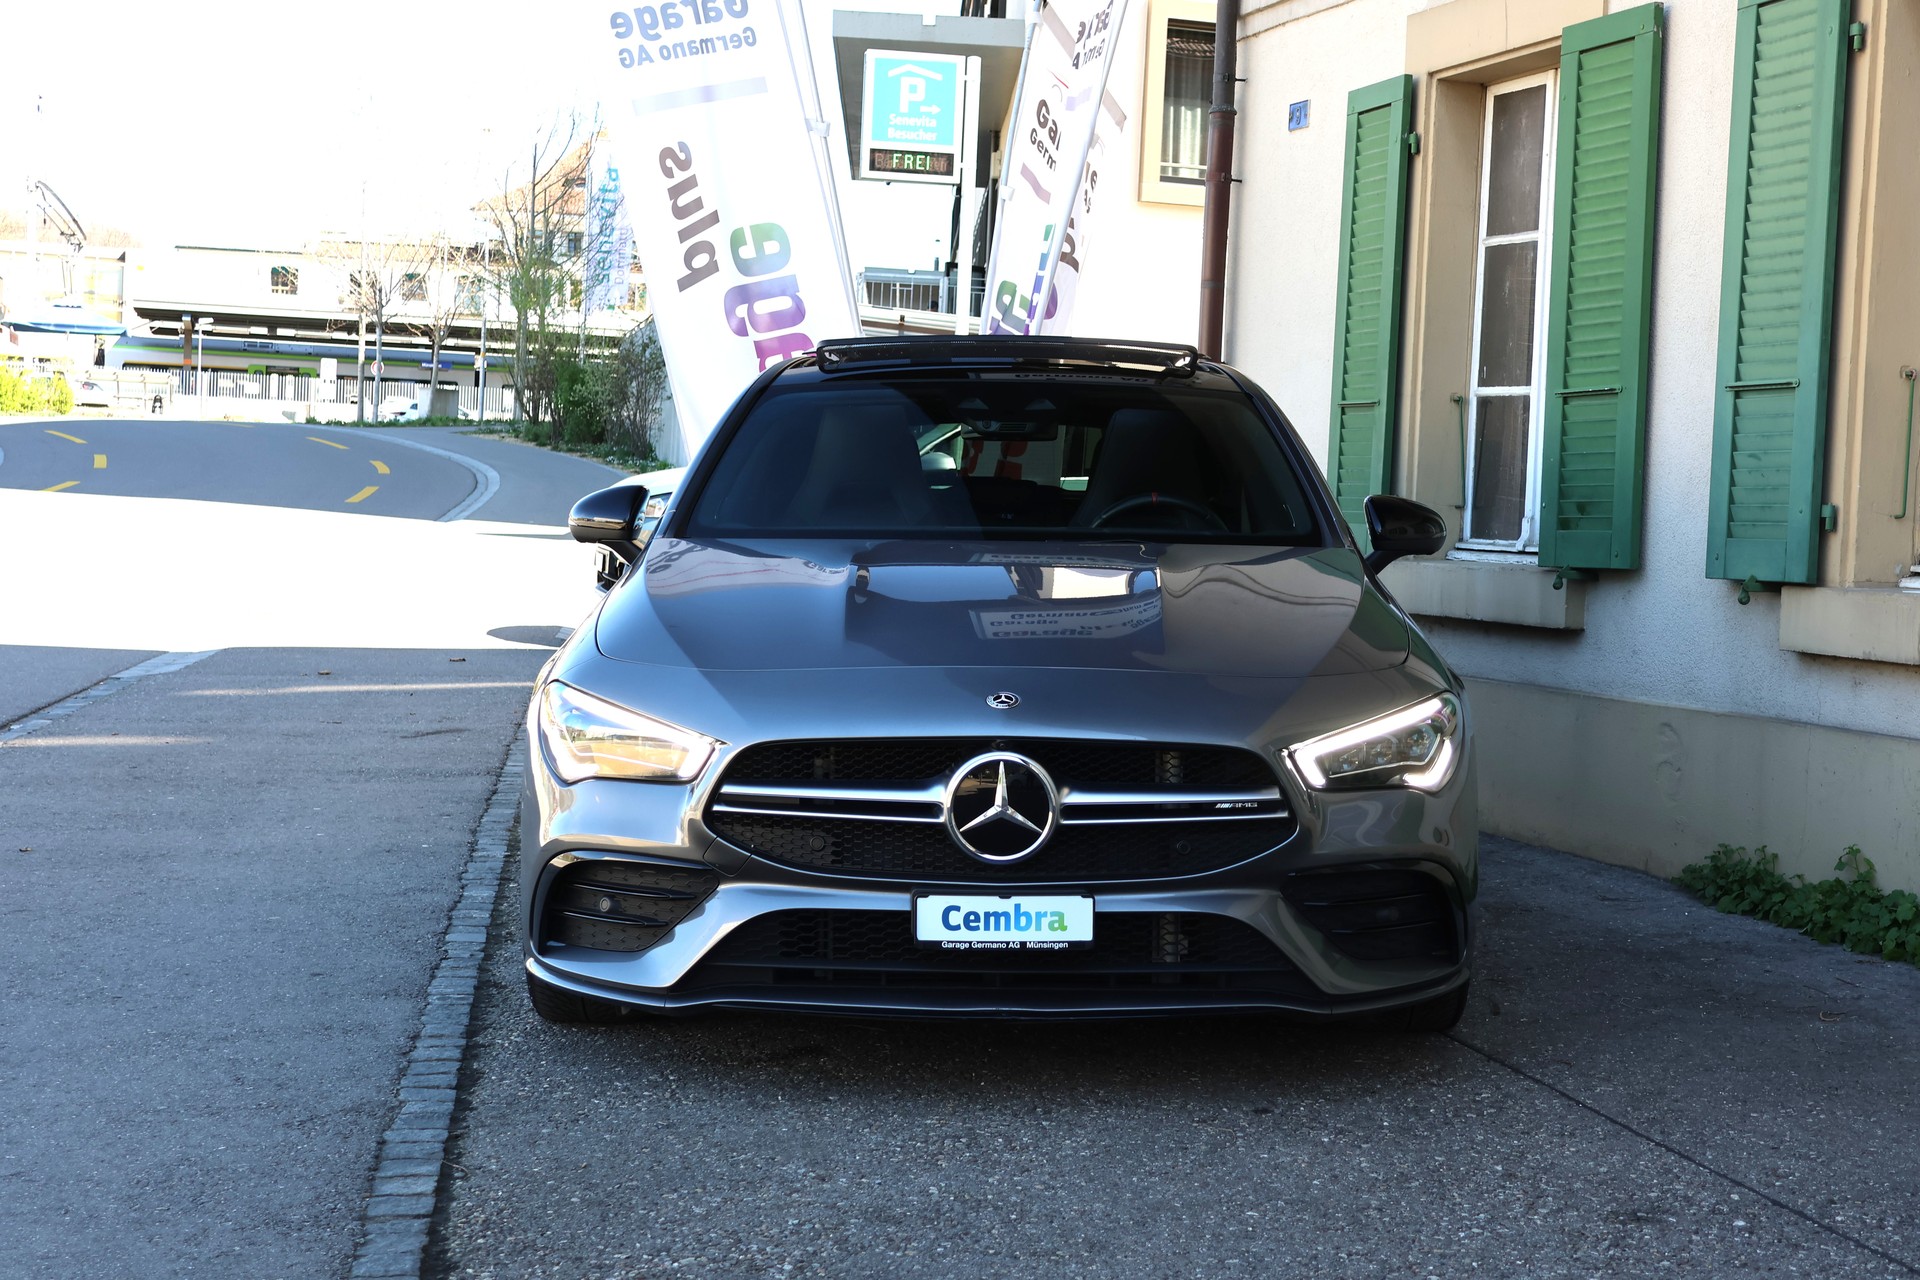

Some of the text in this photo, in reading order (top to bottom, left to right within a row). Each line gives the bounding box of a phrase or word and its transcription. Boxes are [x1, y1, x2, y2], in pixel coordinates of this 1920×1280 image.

[888, 113, 937, 128] Senevita
[887, 127, 938, 141] Besucher
[892, 153, 931, 171] FREI
[941, 903, 1068, 932] Cembra
[941, 940, 1069, 950] Garage Germano AG Münsingen
